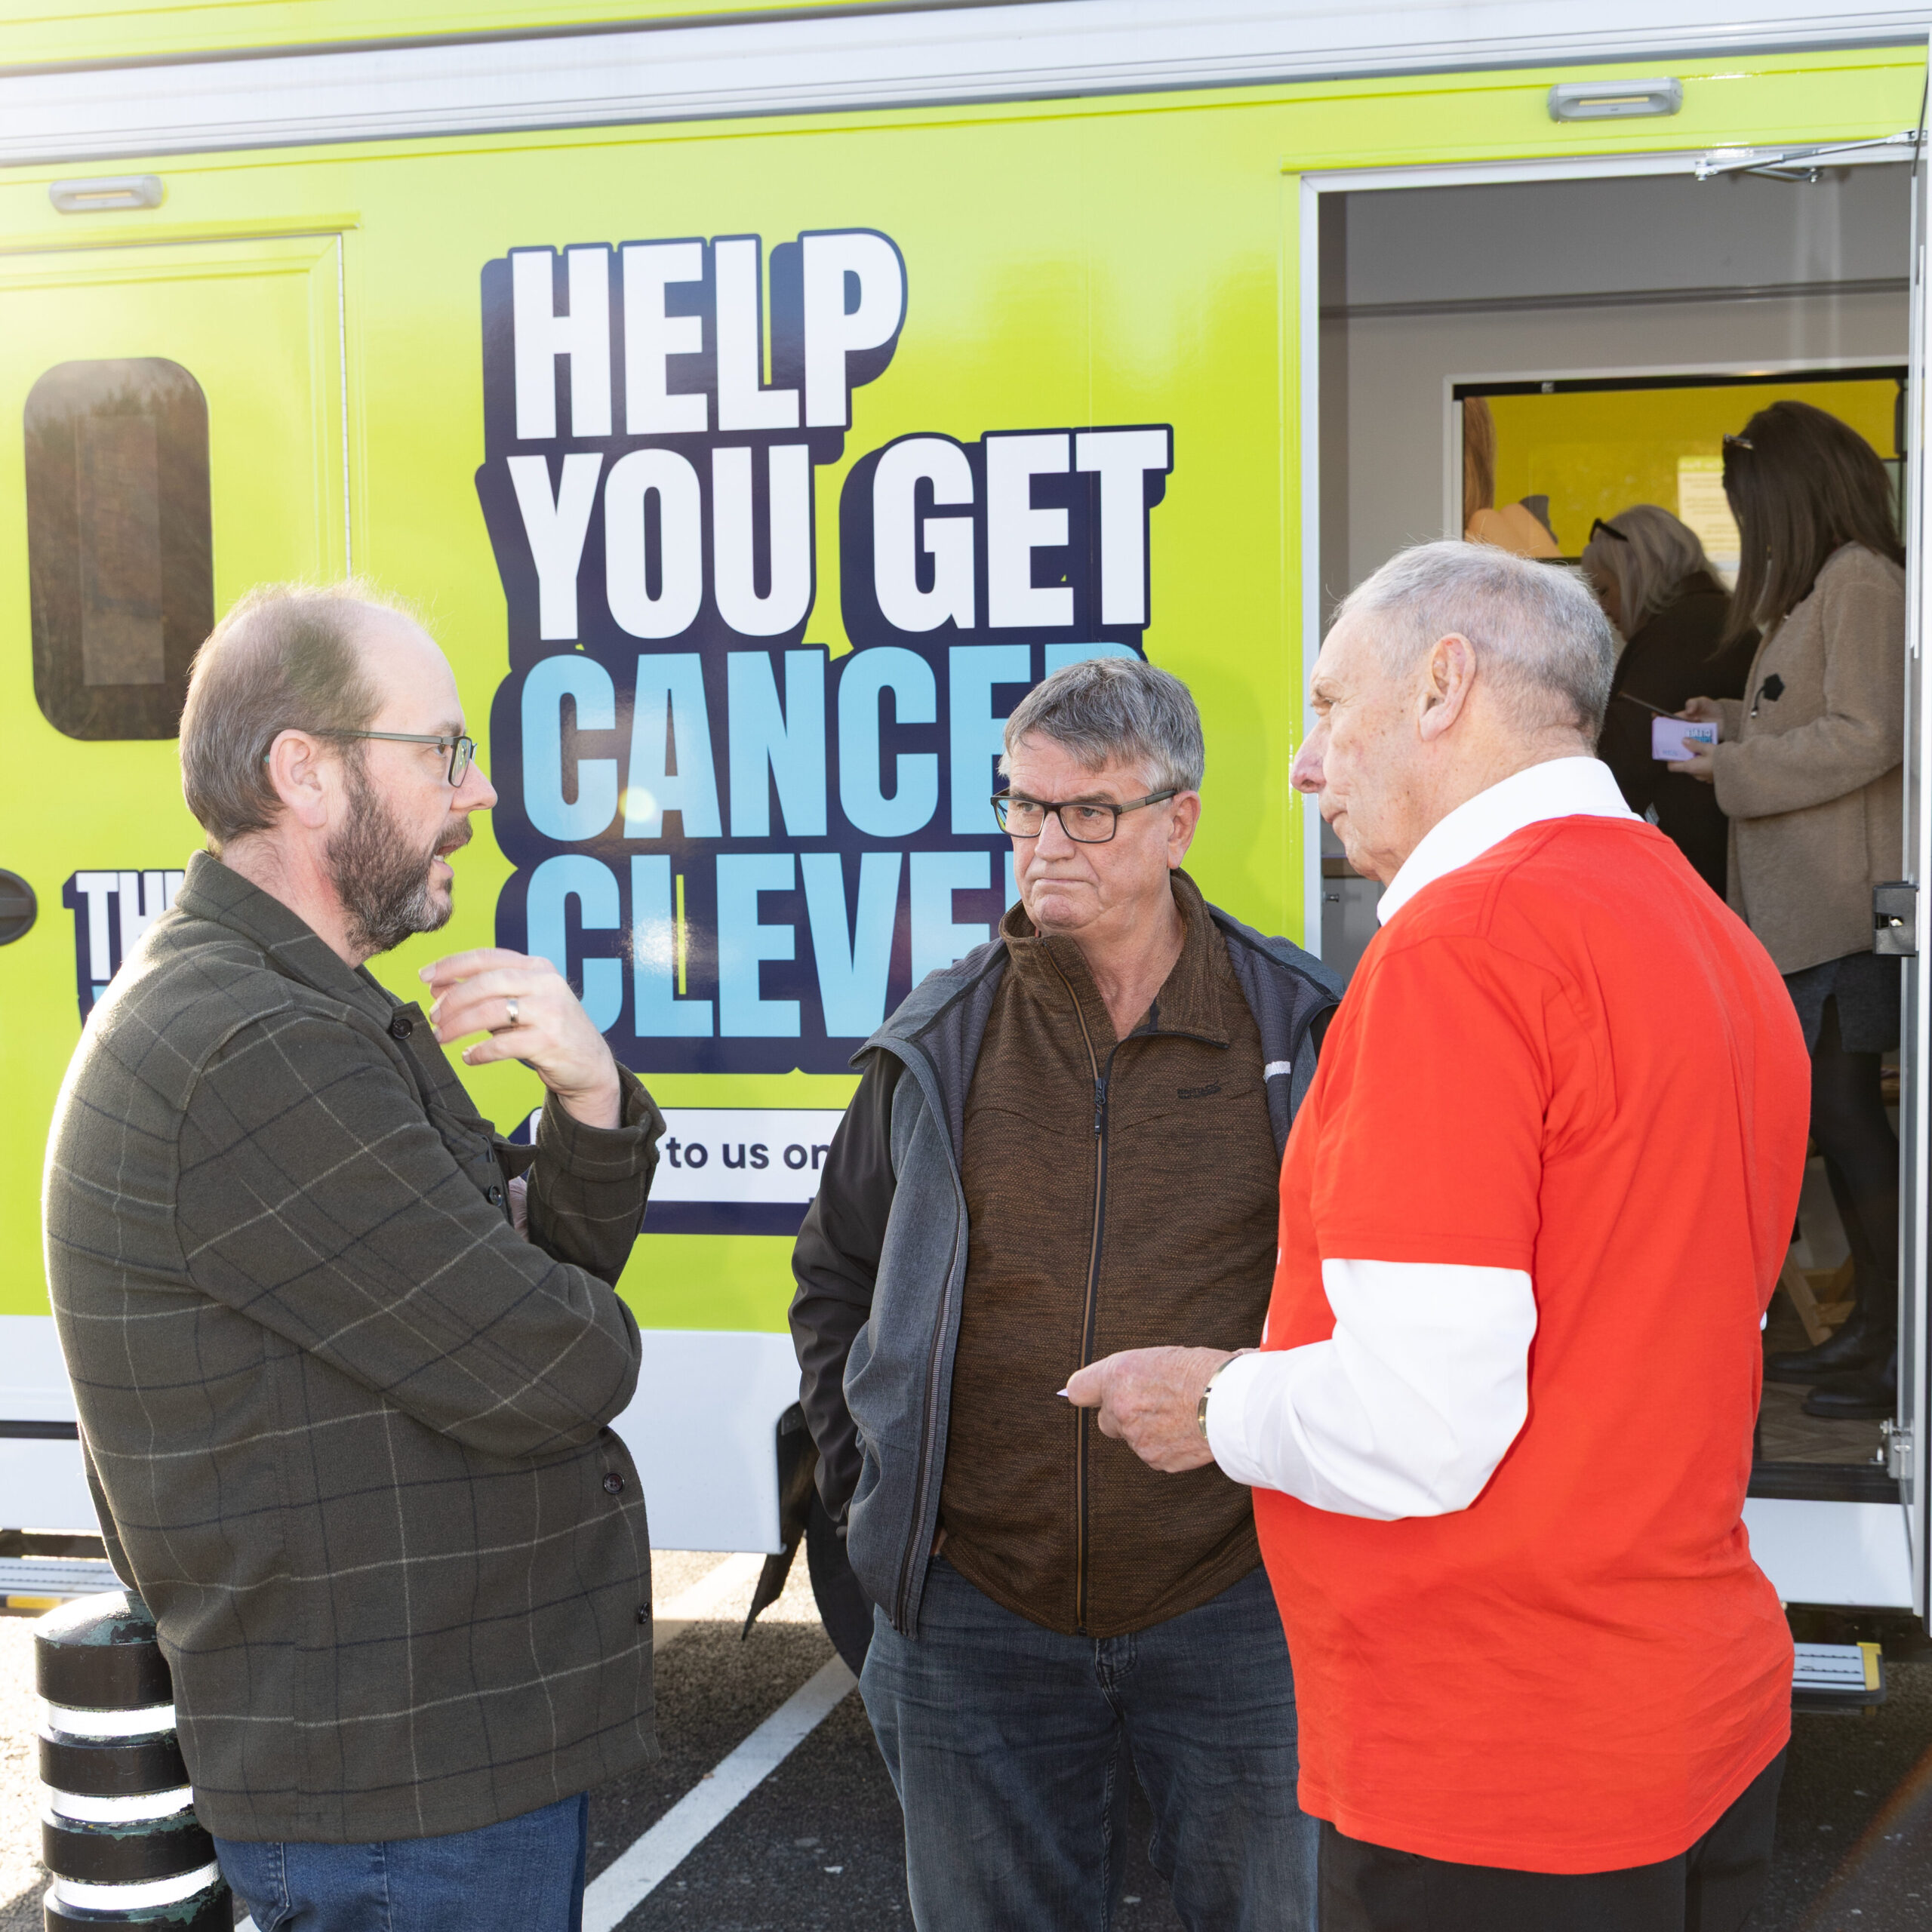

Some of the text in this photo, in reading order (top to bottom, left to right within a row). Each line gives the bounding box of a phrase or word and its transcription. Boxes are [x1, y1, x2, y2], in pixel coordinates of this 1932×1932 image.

[512, 232, 904, 439] HELP
[506, 429, 1169, 640] YOU GET
[521, 642, 1141, 841] CANCE
[527, 851, 1020, 1038] CLEVE
[666, 1137, 709, 1169] to
[722, 1143, 770, 1170] us
